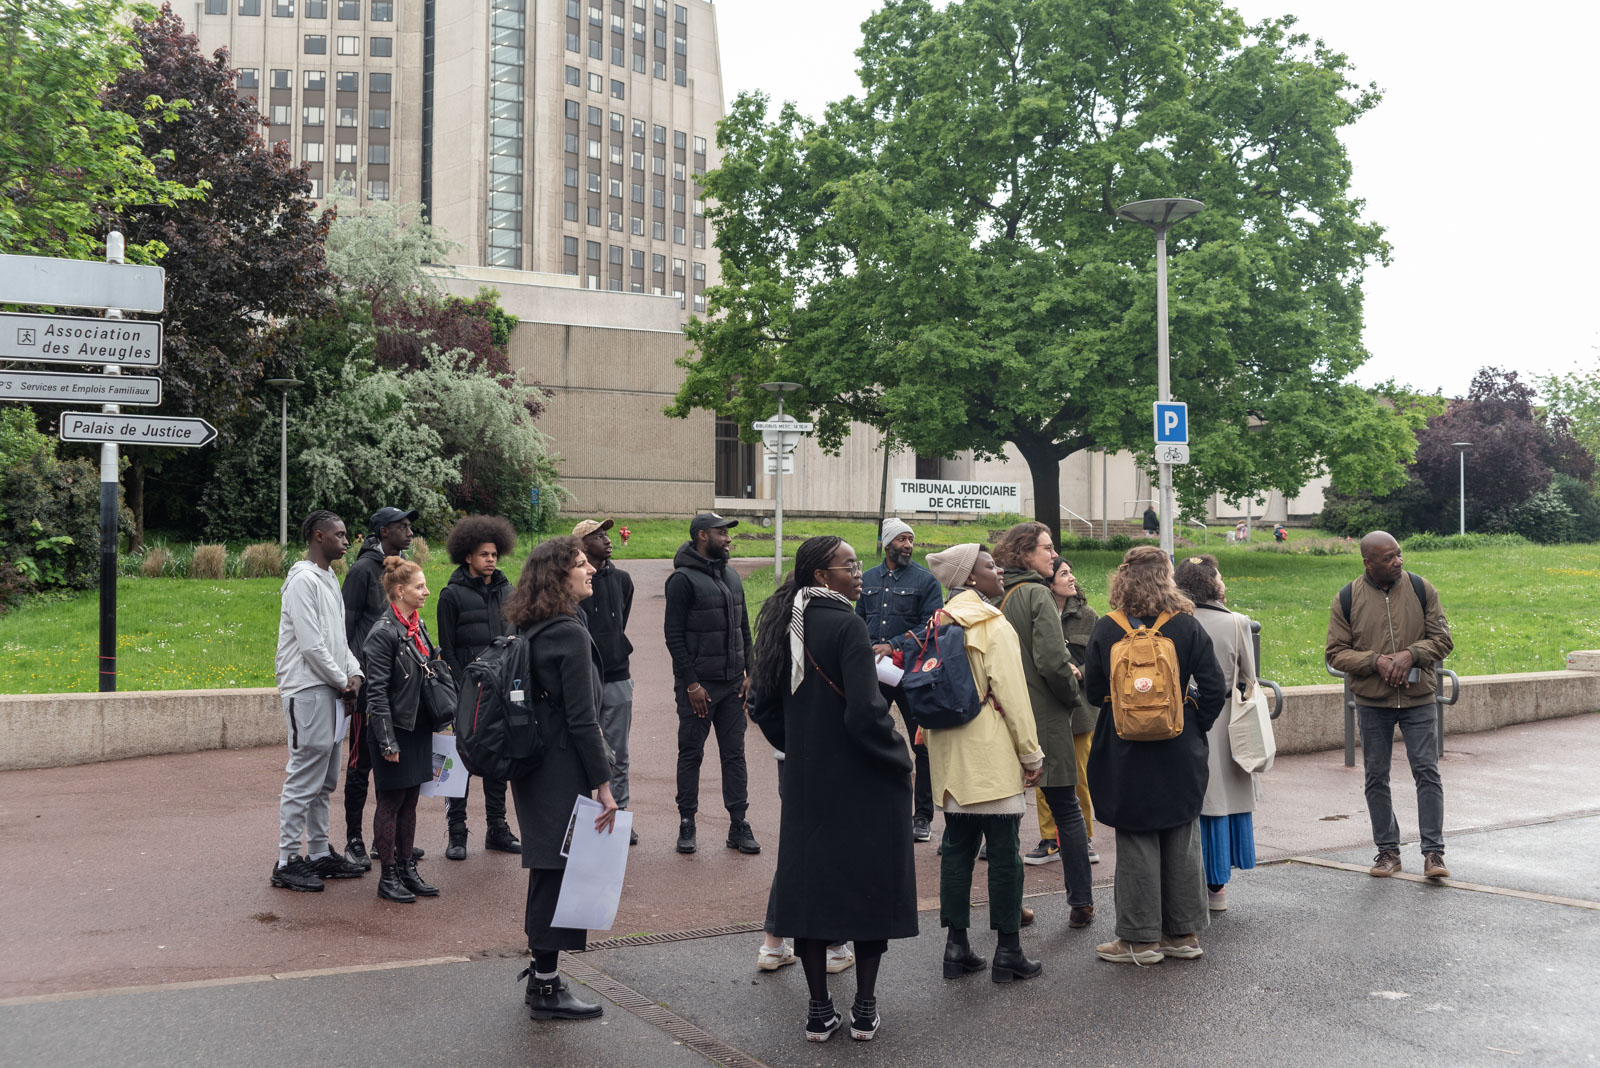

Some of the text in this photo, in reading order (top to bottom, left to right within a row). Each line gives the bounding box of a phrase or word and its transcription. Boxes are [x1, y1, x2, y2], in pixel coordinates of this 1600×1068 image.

[44, 324, 141, 341] Association
[42, 341, 151, 361] des Aveugles
[20, 382, 57, 392] Services
[60, 384, 70, 392] et
[72, 384, 106, 394] Emplois
[108, 386, 150, 396] Familiaux
[72, 420, 192, 438] Palais de Justice
[1164, 410, 1179, 436] P
[900, 482, 1017, 497] TRIBUNAL JUDICIAIRE
[928, 495, 991, 509] DE CRÉTEIL
